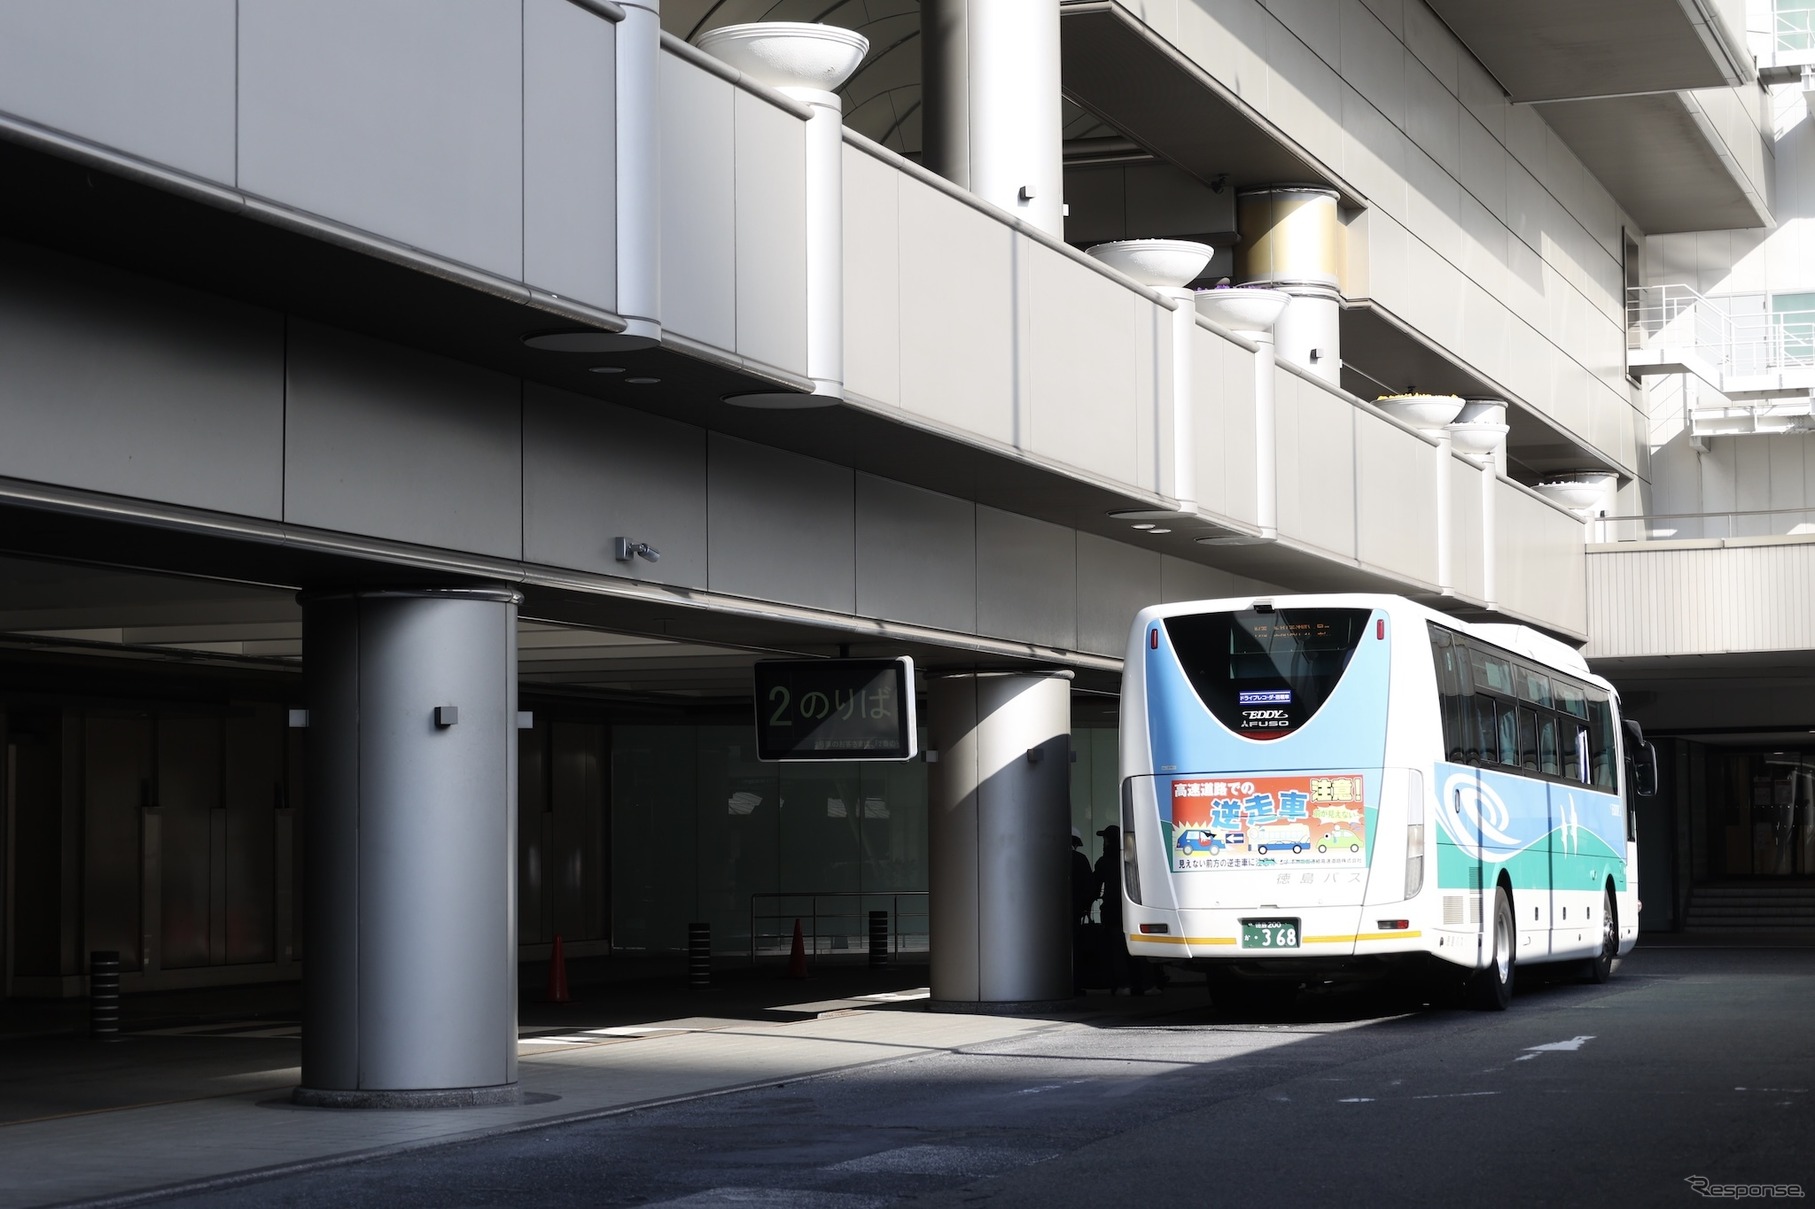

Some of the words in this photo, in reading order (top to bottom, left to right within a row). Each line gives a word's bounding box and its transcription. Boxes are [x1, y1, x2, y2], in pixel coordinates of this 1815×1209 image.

[1243, 710, 1288, 719] EDDY
[1174, 781, 1255, 797] 高速道路での
[1210, 789, 1309, 831] 逆走車
[1276, 872, 1361, 885] 徳島バス
